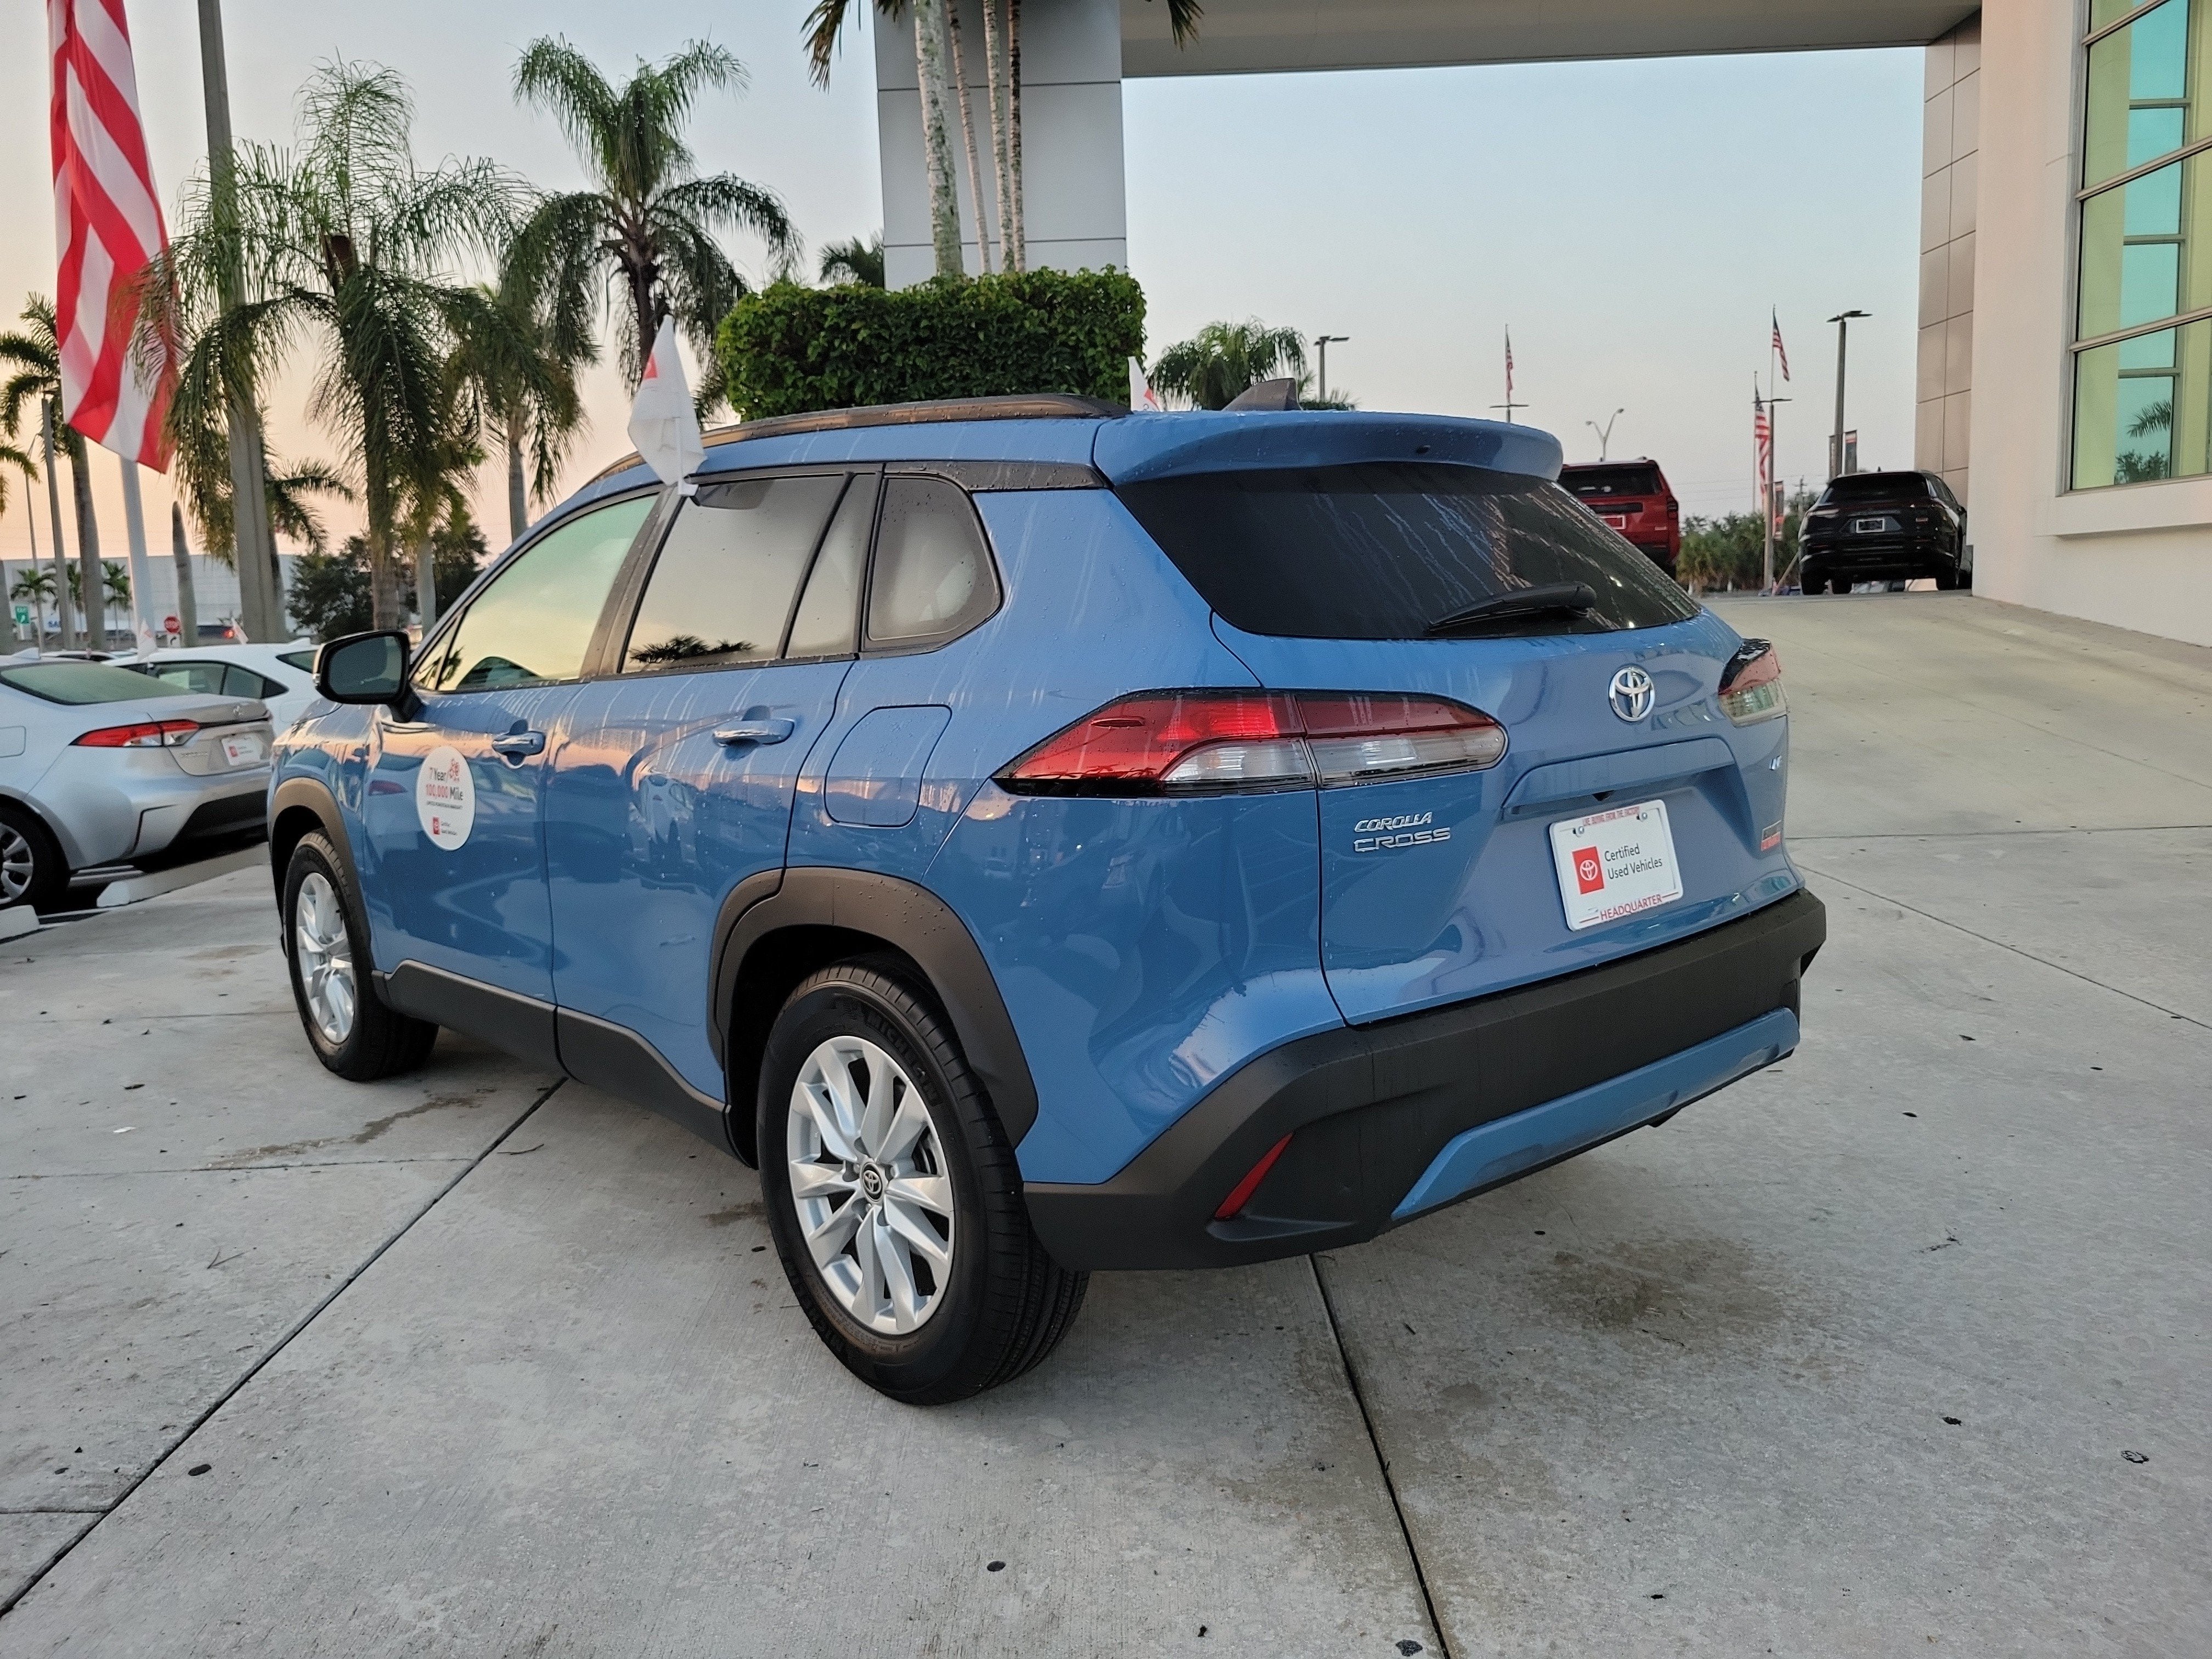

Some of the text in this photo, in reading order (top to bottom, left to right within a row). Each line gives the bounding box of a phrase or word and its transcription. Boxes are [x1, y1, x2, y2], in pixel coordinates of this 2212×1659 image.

[450, 786, 464, 801] Mile
[1355, 811, 1432, 832] COROLLA
[1354, 827, 1451, 852] CROSS
[1605, 844, 1640, 862] Certified
[1607, 857, 1662, 879] Used Vehicles
[1600, 894, 1662, 920] HEADQUARTER
